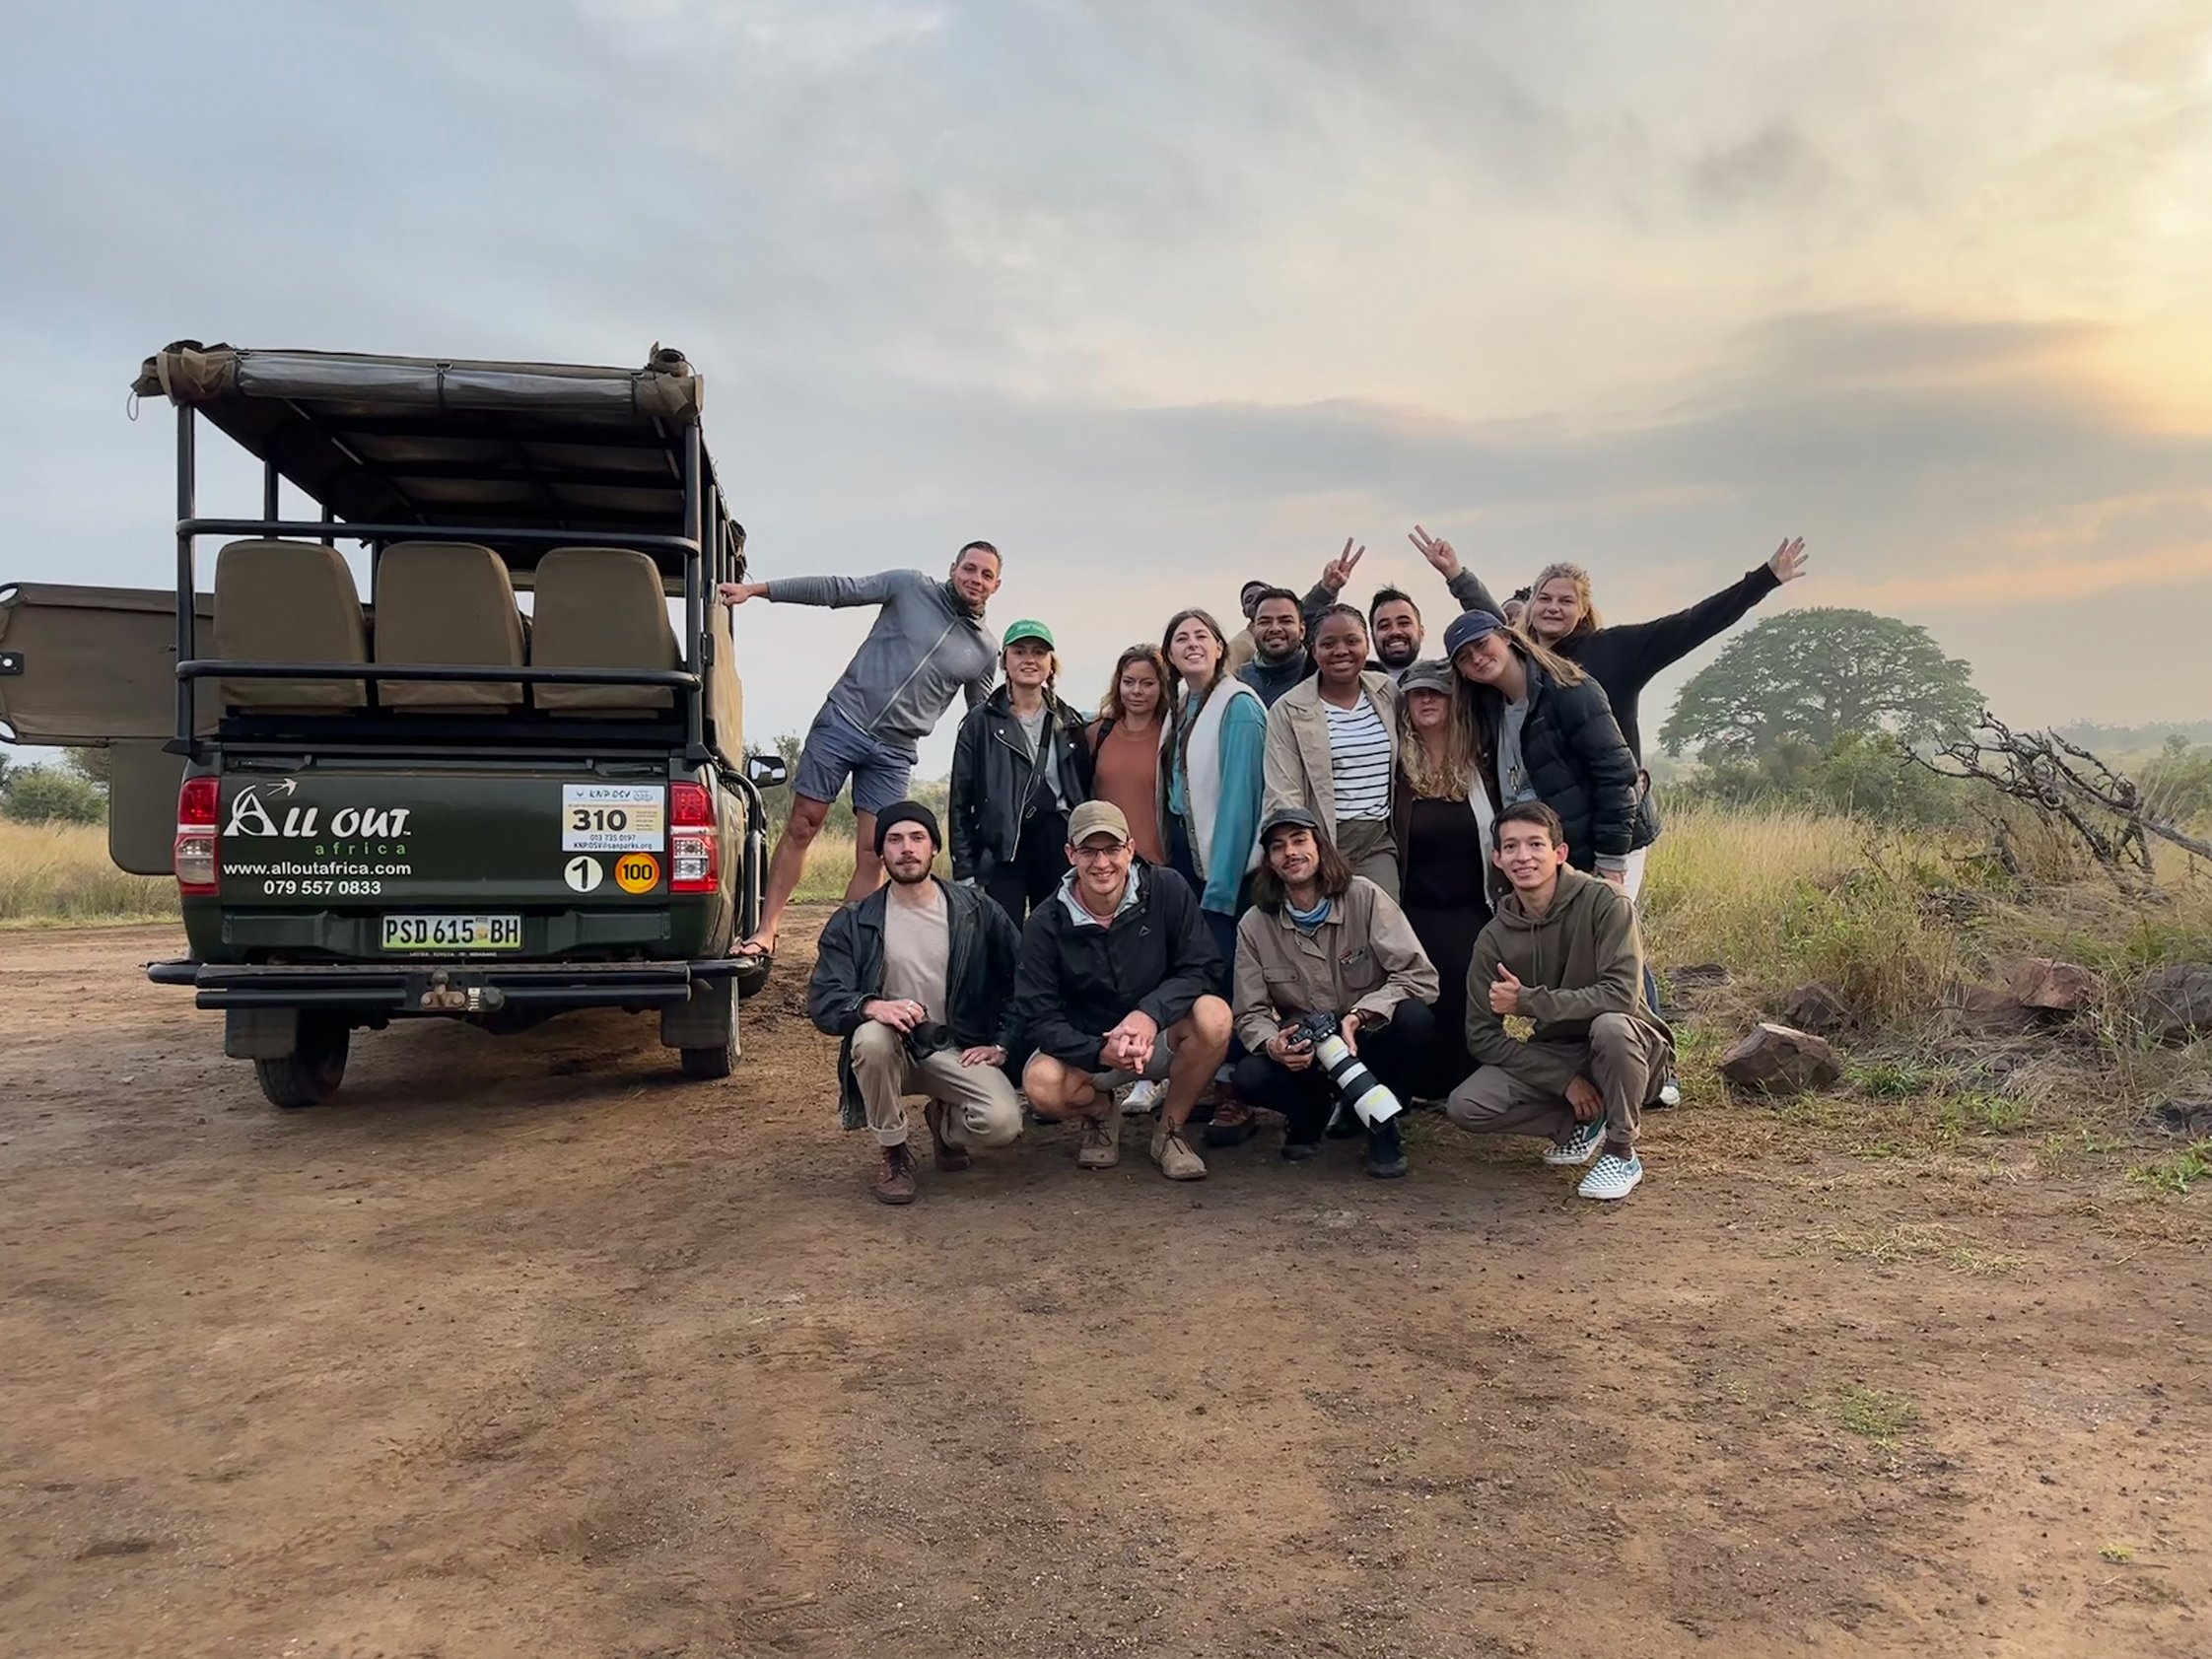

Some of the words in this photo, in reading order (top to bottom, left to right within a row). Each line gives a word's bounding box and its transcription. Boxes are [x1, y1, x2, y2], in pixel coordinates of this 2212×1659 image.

[589, 790, 610, 798] KNP
[612, 790, 631, 798] OSV
[573, 809, 627, 832] 310
[314, 841, 406, 856] africa
[223, 861, 412, 876] www.alloutafrica.com
[572, 859, 588, 890] 1
[622, 864, 653, 881] 100
[263, 879, 297, 896] 079
[301, 879, 334, 896] 557
[338, 879, 382, 896] 0833
[385, 919, 428, 944] PSD
[433, 919, 475, 944] 615
[490, 919, 518, 944] BH
